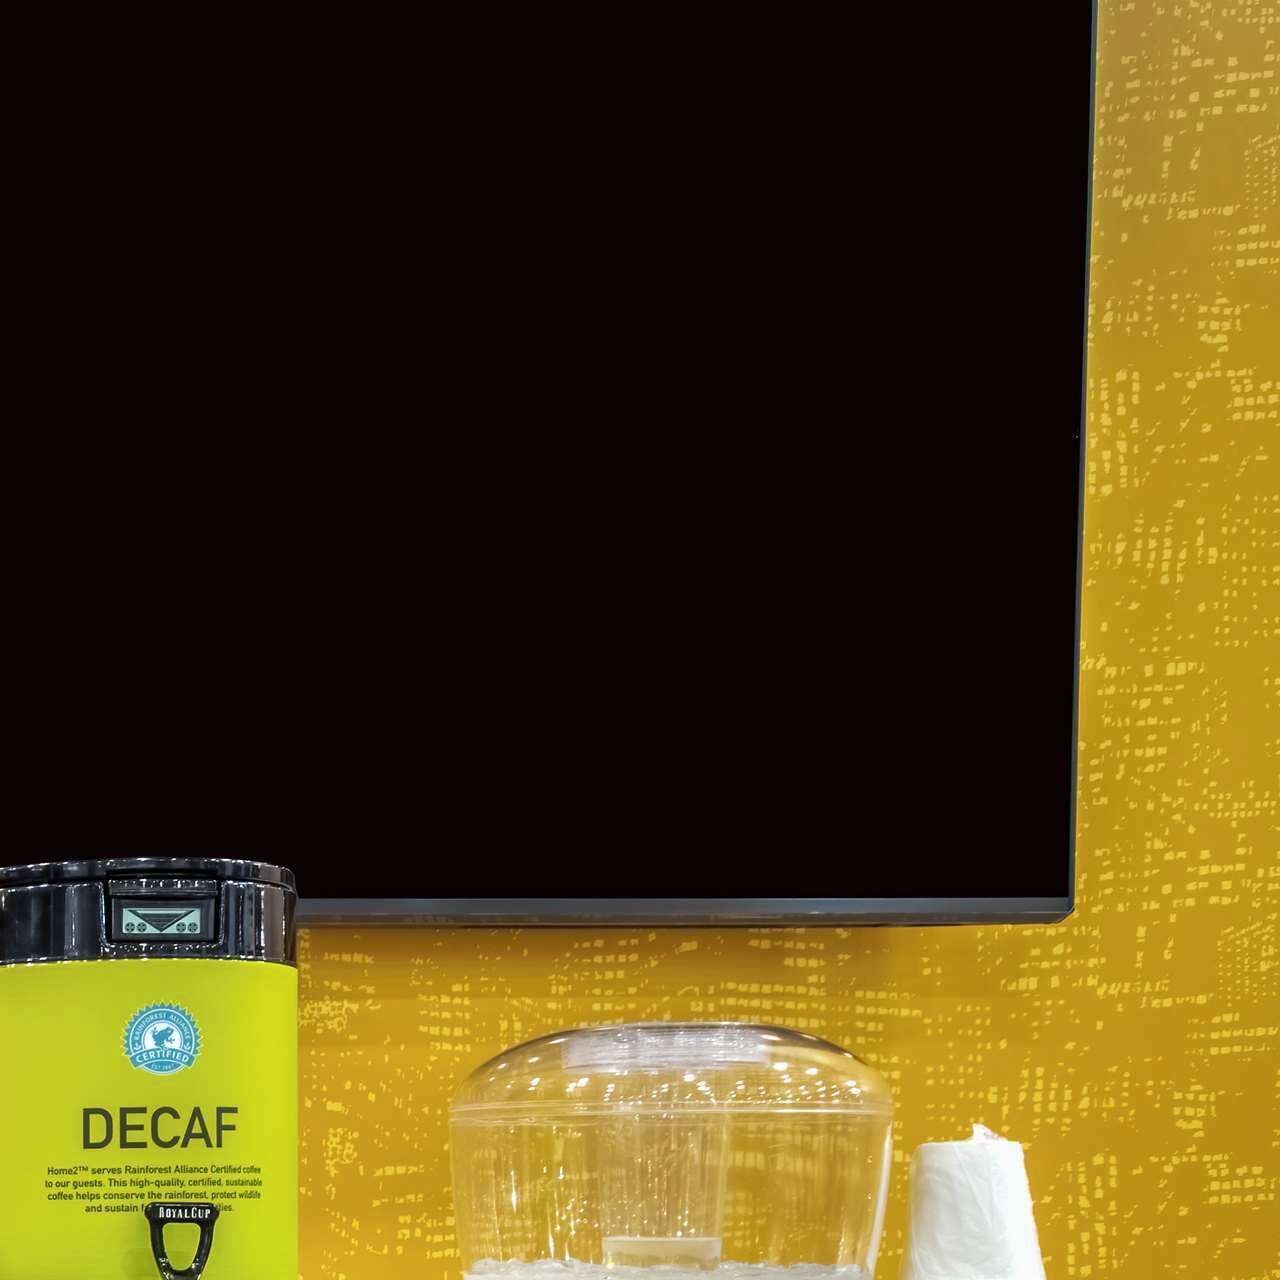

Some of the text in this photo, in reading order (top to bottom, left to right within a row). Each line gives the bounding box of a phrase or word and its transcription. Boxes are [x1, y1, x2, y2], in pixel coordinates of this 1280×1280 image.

[136, 1050, 189, 1063] CERTIFIED
[82, 1106, 238, 1149] DECAF
[125, 1165, 171, 1174] Rainforest
[174, 1165, 208, 1174] Alliance
[210, 1165, 242, 1174] Certified
[45, 1180, 53, 1188] to
[73, 1180, 103, 1189] guests.
[108, 1179, 127, 1187] This
[48, 1191, 74, 1201] coffee
[76, 1191, 100, 1202] helps
[148, 1191, 162, 1199] the
[211, 1191, 237, 1200] protect
[239, 1191, 260, 1199] wildlife
[85, 1204, 102, 1212] and
[105, 1204, 138, 1212] sustain
